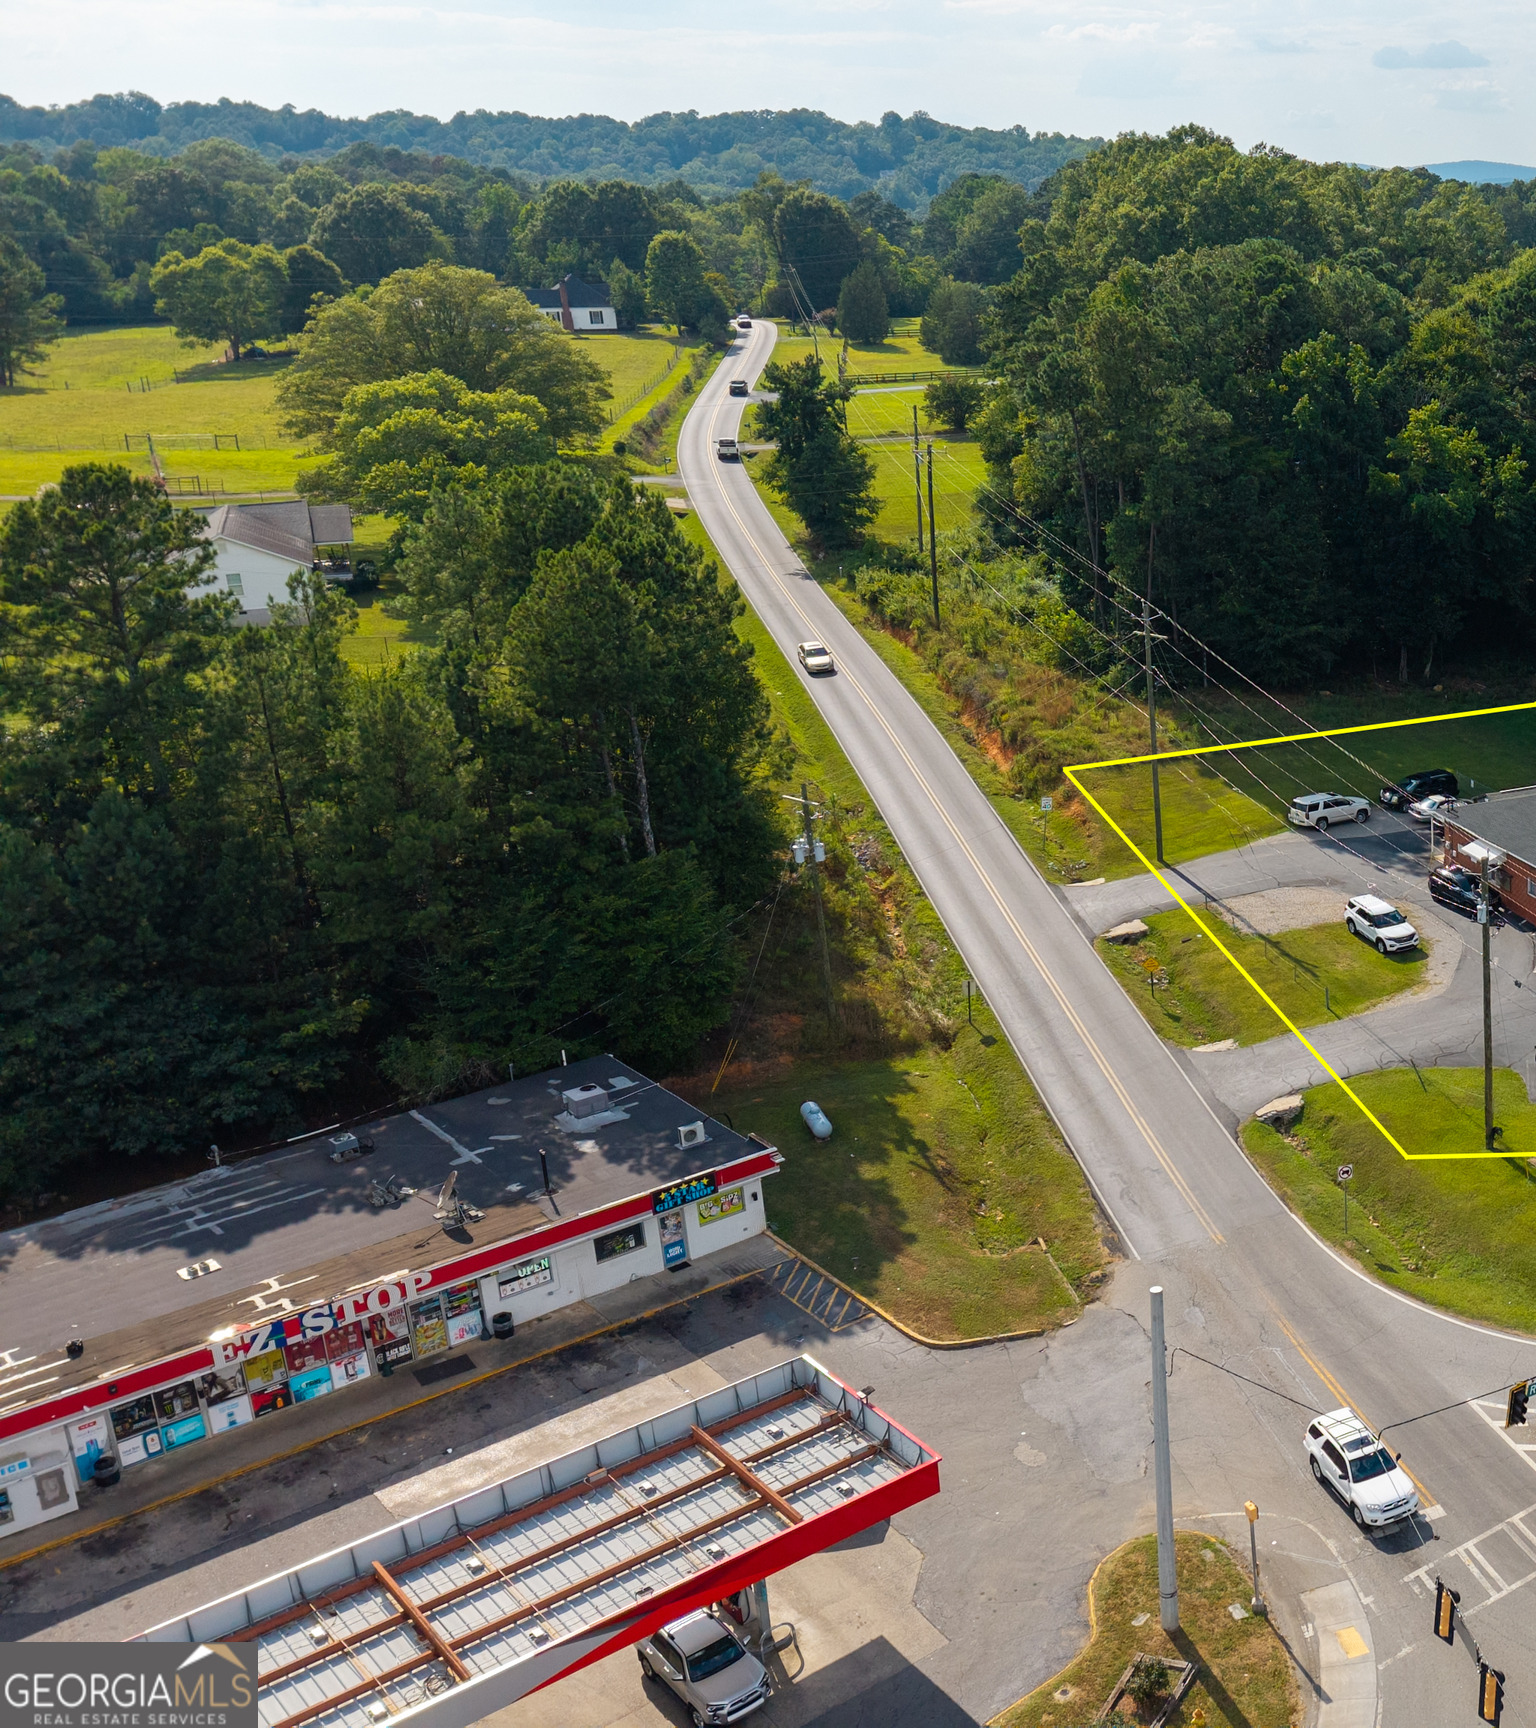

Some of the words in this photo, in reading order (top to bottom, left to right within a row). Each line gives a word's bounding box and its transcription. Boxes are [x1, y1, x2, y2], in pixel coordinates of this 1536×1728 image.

[655, 1196, 683, 1212] GIFT
[685, 1185, 715, 1202] SHOP
[675, 1182, 706, 1197] STAR
[208, 1325, 277, 1372] EZ
[302, 1272, 432, 1339] STOP
